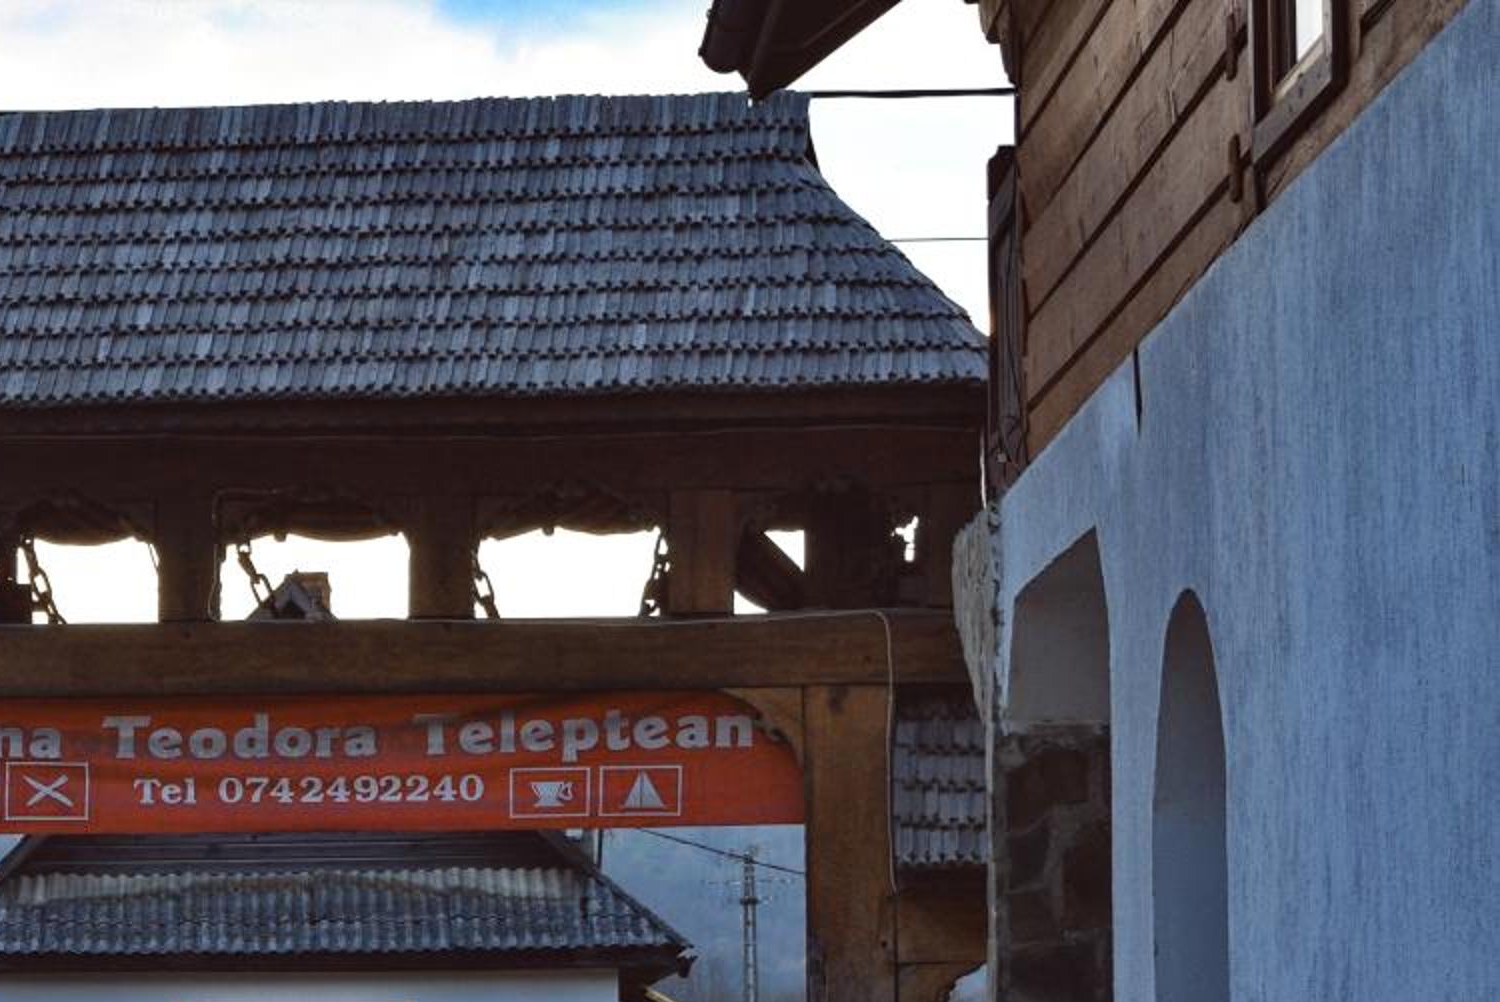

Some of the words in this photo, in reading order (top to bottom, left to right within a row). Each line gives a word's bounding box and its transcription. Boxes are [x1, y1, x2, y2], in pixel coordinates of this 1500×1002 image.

[102, 711, 378, 760] Teodora
[412, 708, 754, 763] Teleptean
[133, 777, 198, 805] Tel
[217, 774, 486, 806] 0742492240
